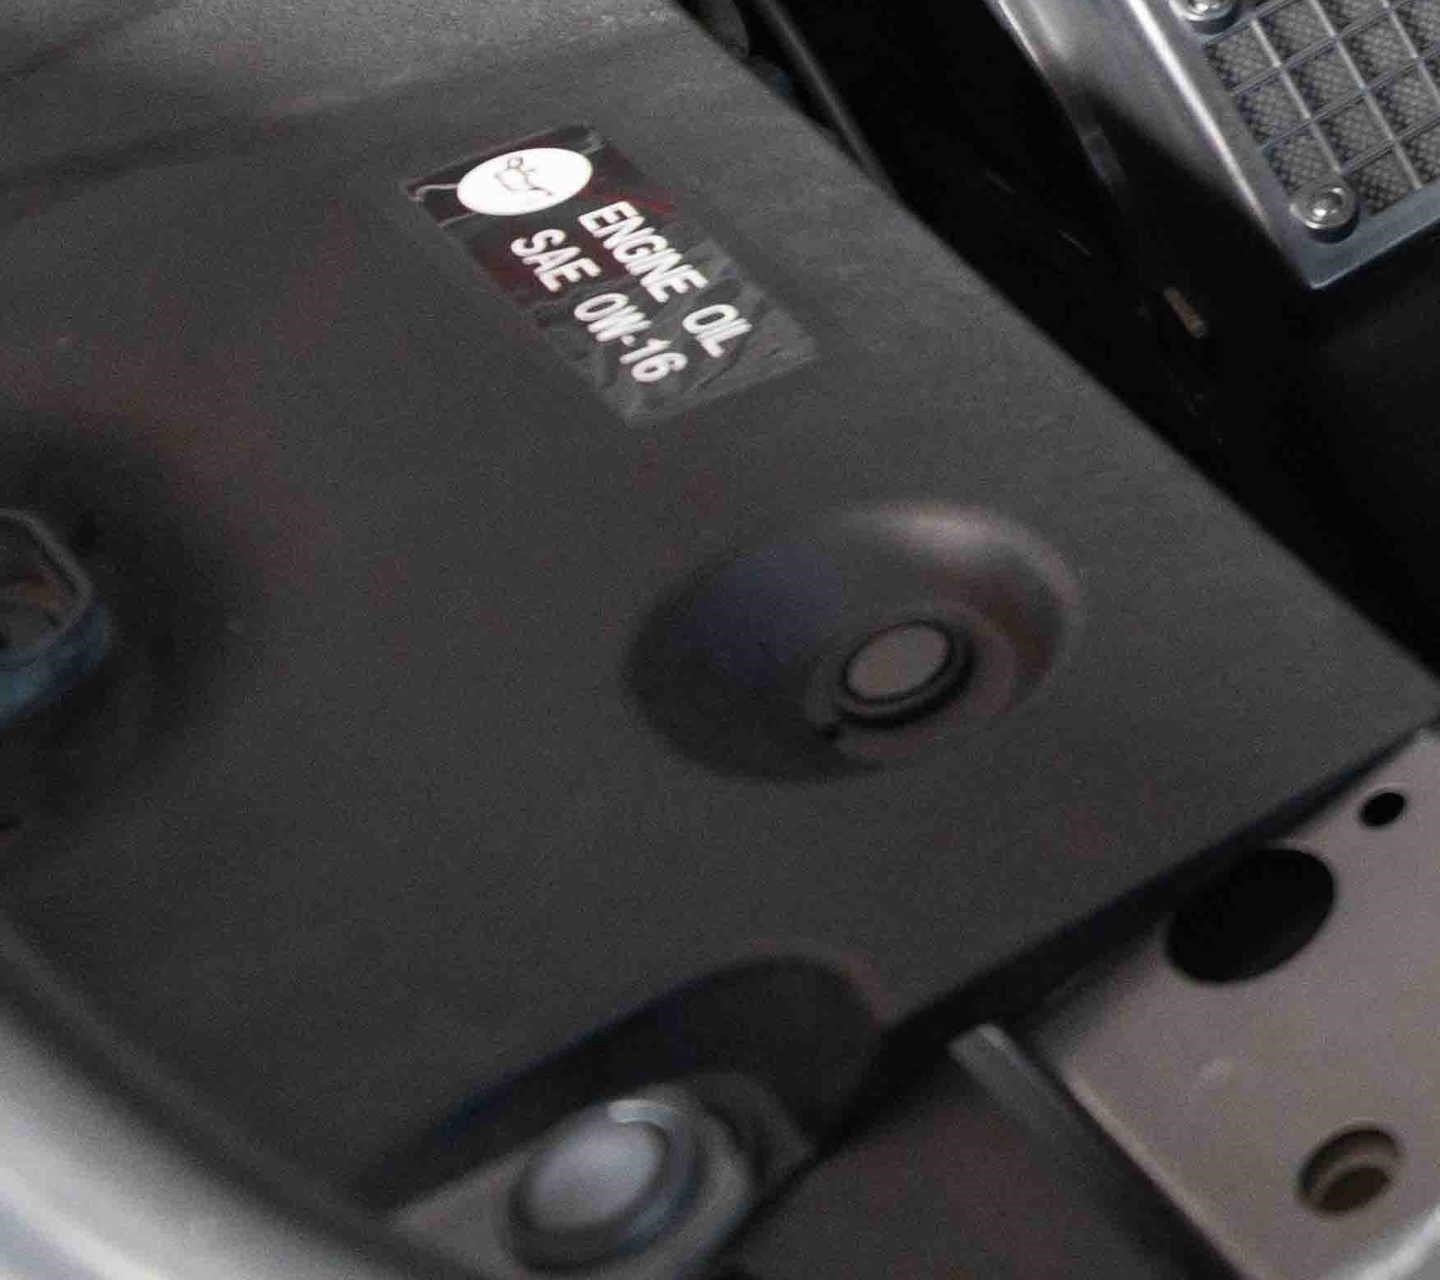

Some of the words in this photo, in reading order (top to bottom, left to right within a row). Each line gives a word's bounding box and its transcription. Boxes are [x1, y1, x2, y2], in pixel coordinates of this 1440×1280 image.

[510, 228, 602, 294] SAE
[578, 200, 709, 304] ENGINE
[681, 303, 752, 358] OIL
